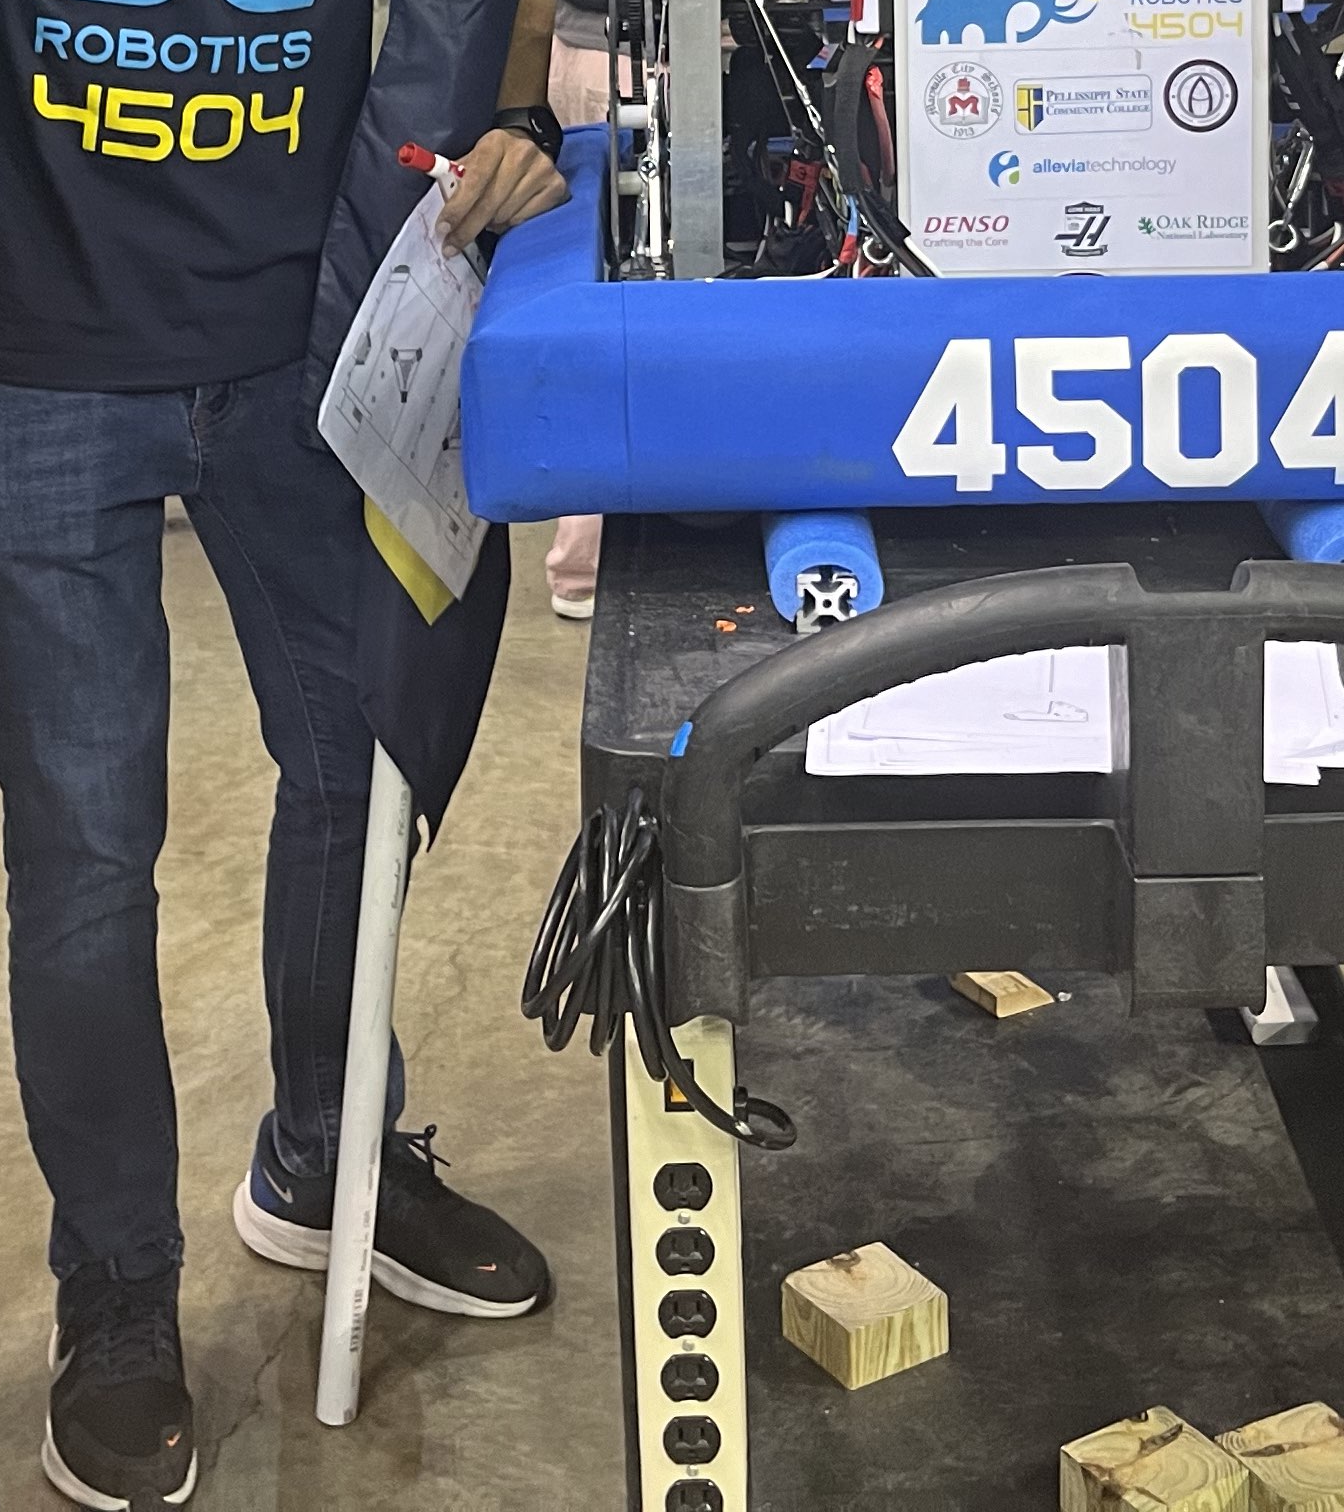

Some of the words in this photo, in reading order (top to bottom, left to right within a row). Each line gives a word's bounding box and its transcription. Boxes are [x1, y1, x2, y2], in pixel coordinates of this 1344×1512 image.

[1128, 11, 1244, 41] 4504
[33, 16, 313, 75] ROBOTICS
[1116, 88, 1150, 101] STATE
[32, 73, 305, 163] 4504
[1105, 102, 1151, 115] COLLEGE
[1032, 156, 1178, 176] alleviatechnology
[923, 215, 1010, 234] DENSO
[1155, 215, 1194, 229] OAK
[1196, 214, 1250, 229] RIDGE
[922, 238, 965, 249] Crafting
[965, 238, 983, 248] the
[984, 237, 1009, 248] Core
